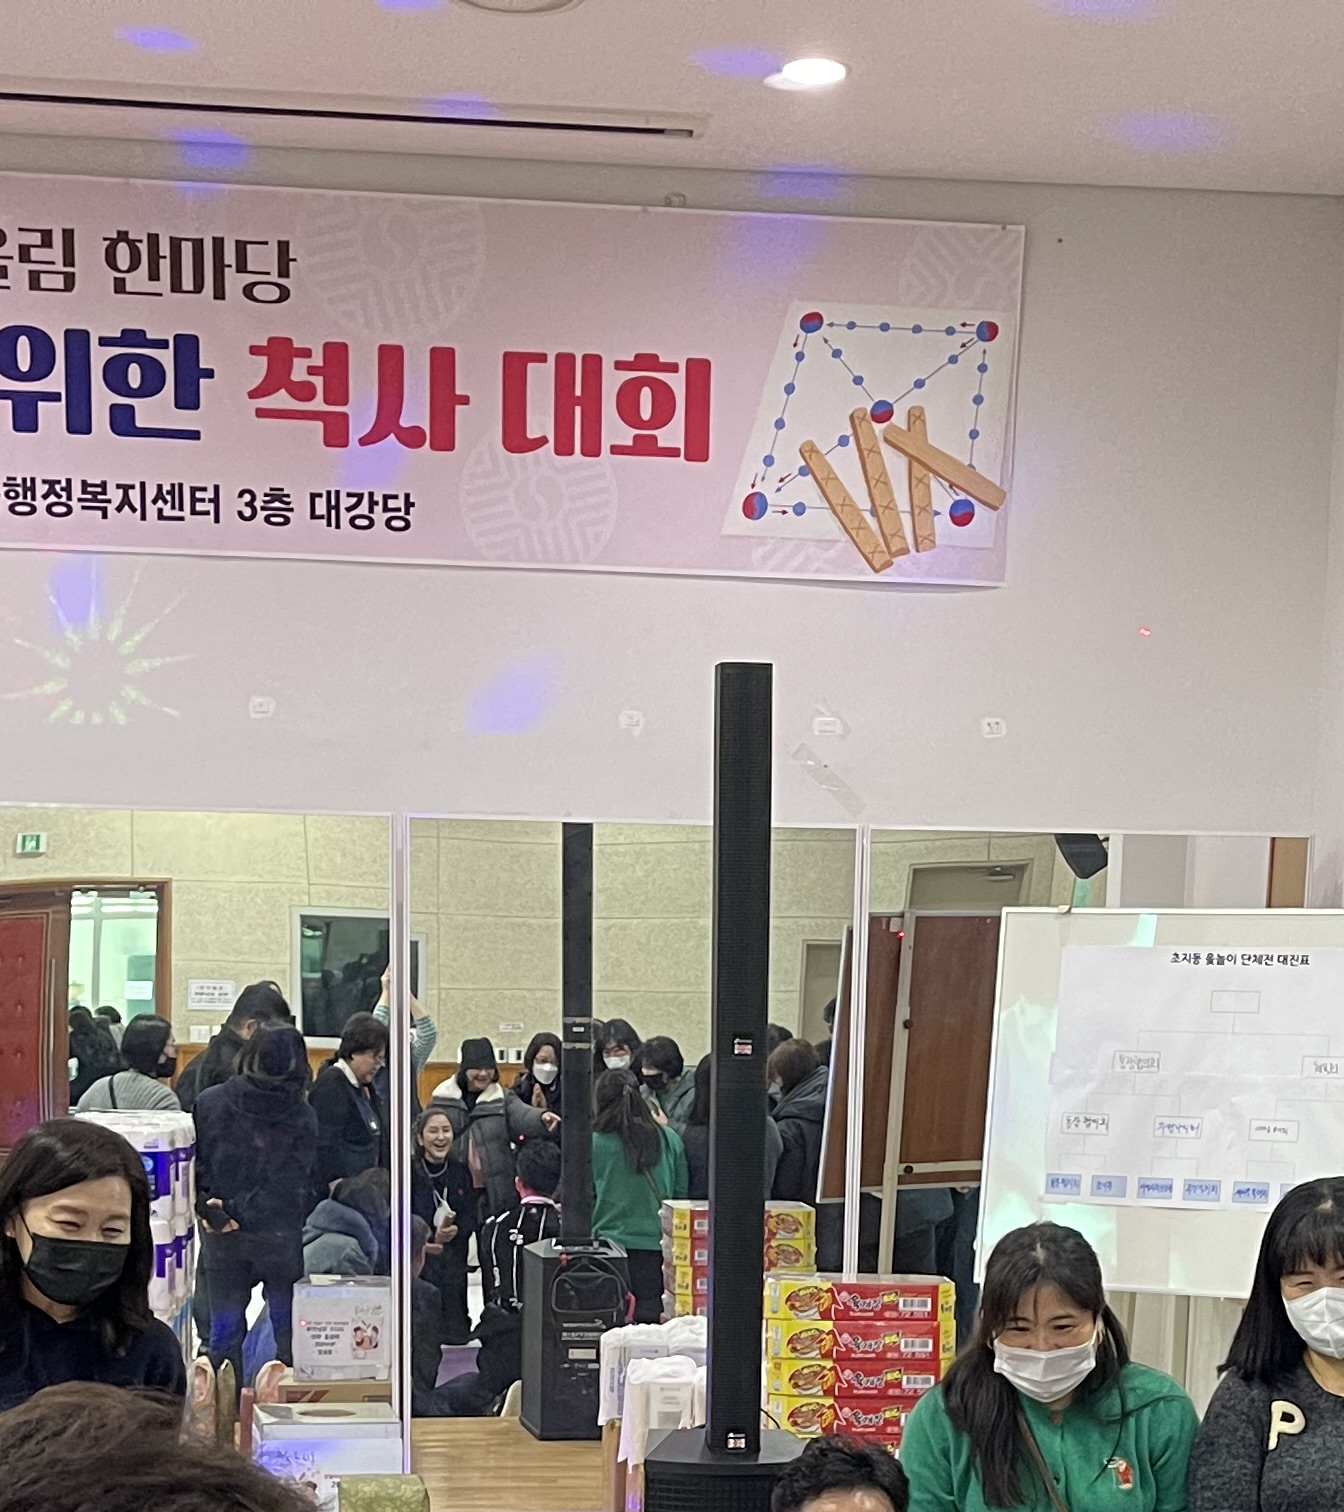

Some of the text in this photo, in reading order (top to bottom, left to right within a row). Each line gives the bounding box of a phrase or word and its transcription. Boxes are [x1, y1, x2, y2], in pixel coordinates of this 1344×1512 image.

[102, 231, 297, 306] 한마당
[247, 336, 470, 455] 척사
[502, 350, 713, 464] 대회
[236, 487, 295, 529] 3층
[307, 487, 416, 534] 대강당
[1170, 952, 1201, 966] 초지동
[1277, 954, 1310, 967] 대진표
[1268, 1400, 1306, 1451] P
